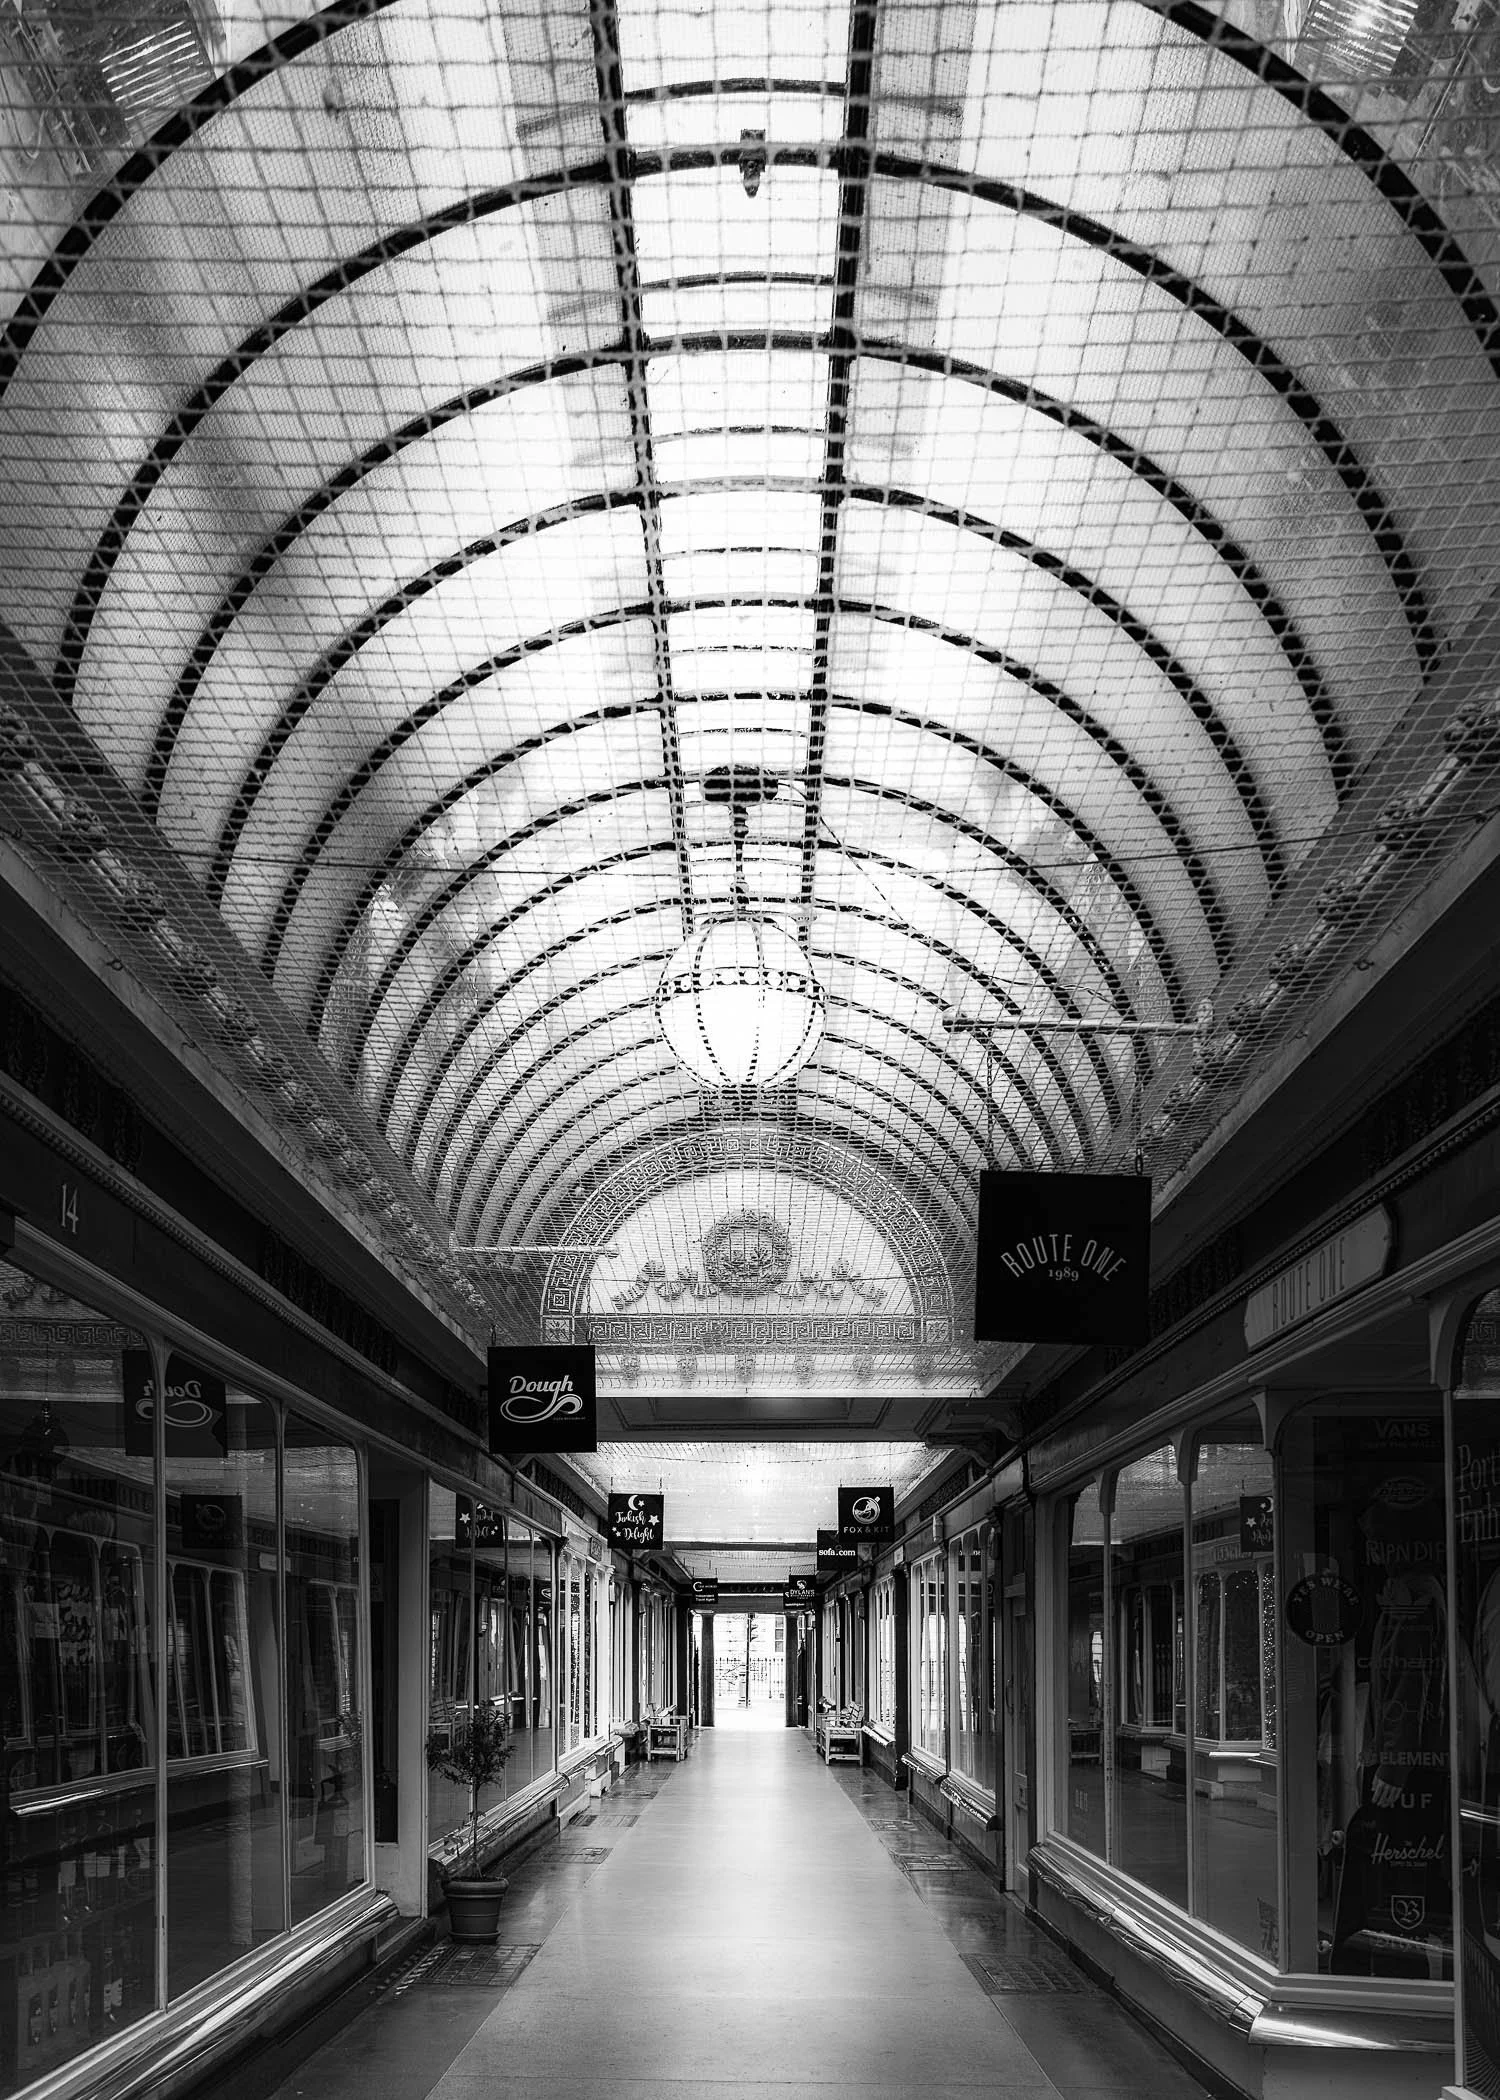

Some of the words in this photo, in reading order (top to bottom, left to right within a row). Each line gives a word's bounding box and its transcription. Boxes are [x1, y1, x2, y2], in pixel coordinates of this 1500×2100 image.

[61, 1183, 80, 1235] 14
[1000, 1233, 1073, 1279] ROUTE
[1080, 1239, 1127, 1282] ONE
[1047, 1266, 1080, 1282] 1989
[1272, 1260, 1311, 1333] ROUTE
[1318, 1235, 1345, 1302] ONE
[508, 1373, 574, 1395] Dough
[1372, 1417, 1432, 1440] VANS
[614, 1509, 646, 1526] Turkish
[621, 1526, 655, 1544] Delight
[842, 1525, 864, 1534] FOX
[864, 1526, 873, 1534] &
[873, 1526, 890, 1534] KIT
[818, 1547, 857, 1557] sofa.com
[1304, 1630, 1345, 1644] OPEN
[1370, 1831, 1445, 1865] Herschel
